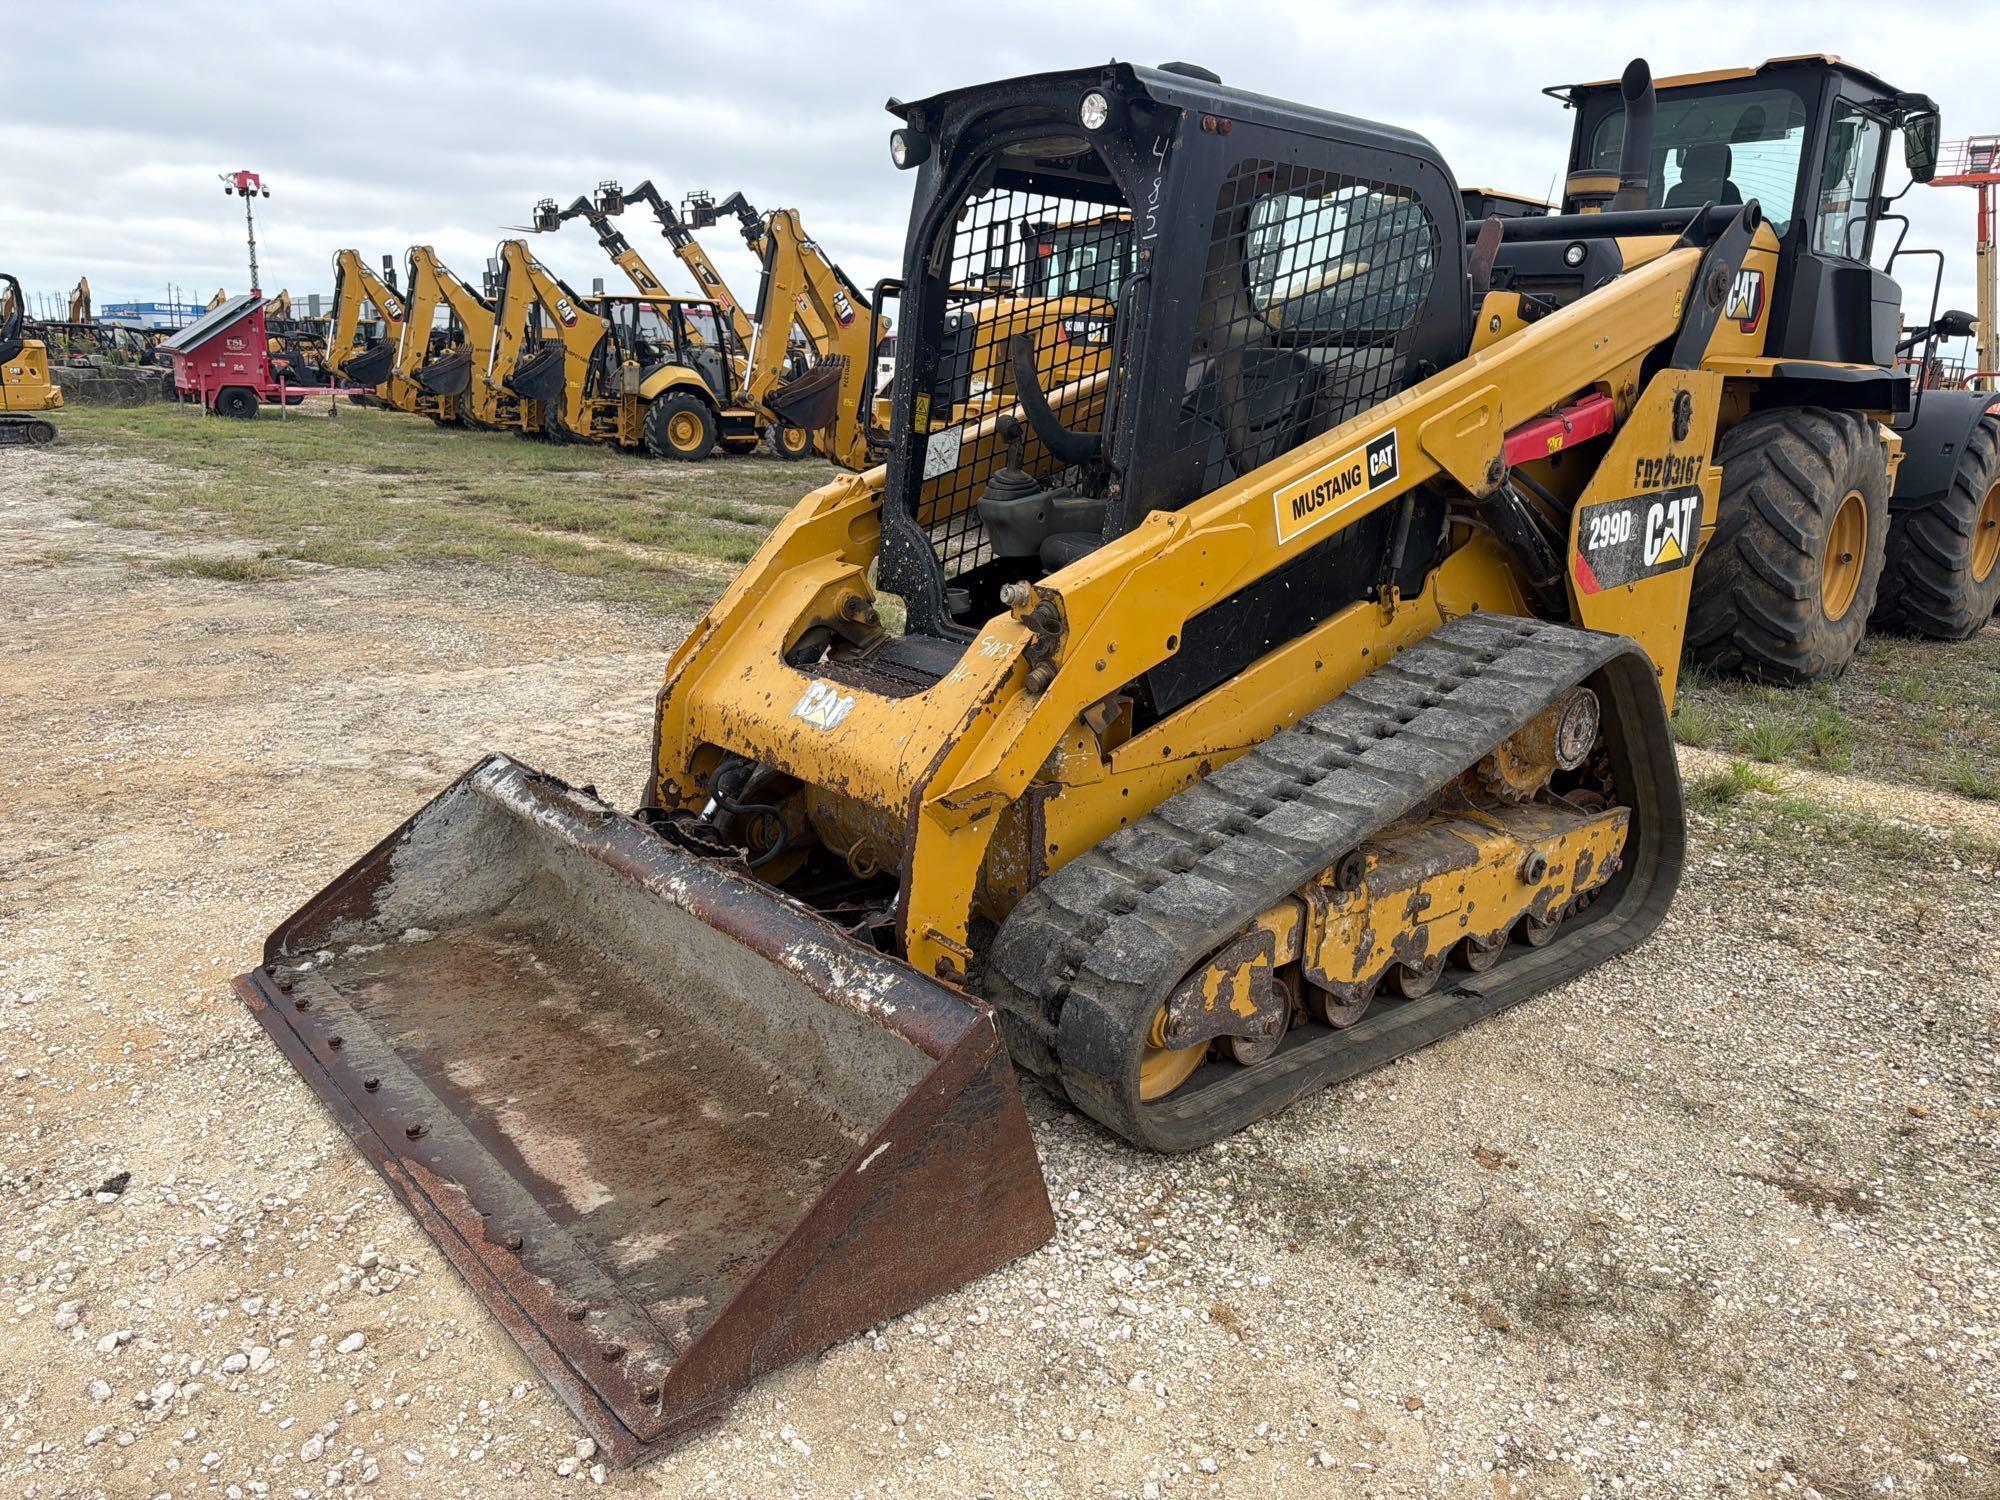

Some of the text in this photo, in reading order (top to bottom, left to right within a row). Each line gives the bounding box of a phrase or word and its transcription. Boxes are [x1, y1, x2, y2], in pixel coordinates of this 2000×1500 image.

[384, 298, 402, 317] CAT
[556, 299, 577, 321] CAT
[833, 291, 854, 320] CAT
[1727, 271, 1760, 319] CAT
[1291, 444, 1393, 520] MUSTANG CAT
[1643, 496, 1698, 567] CAT
[793, 681, 857, 730] CAT
